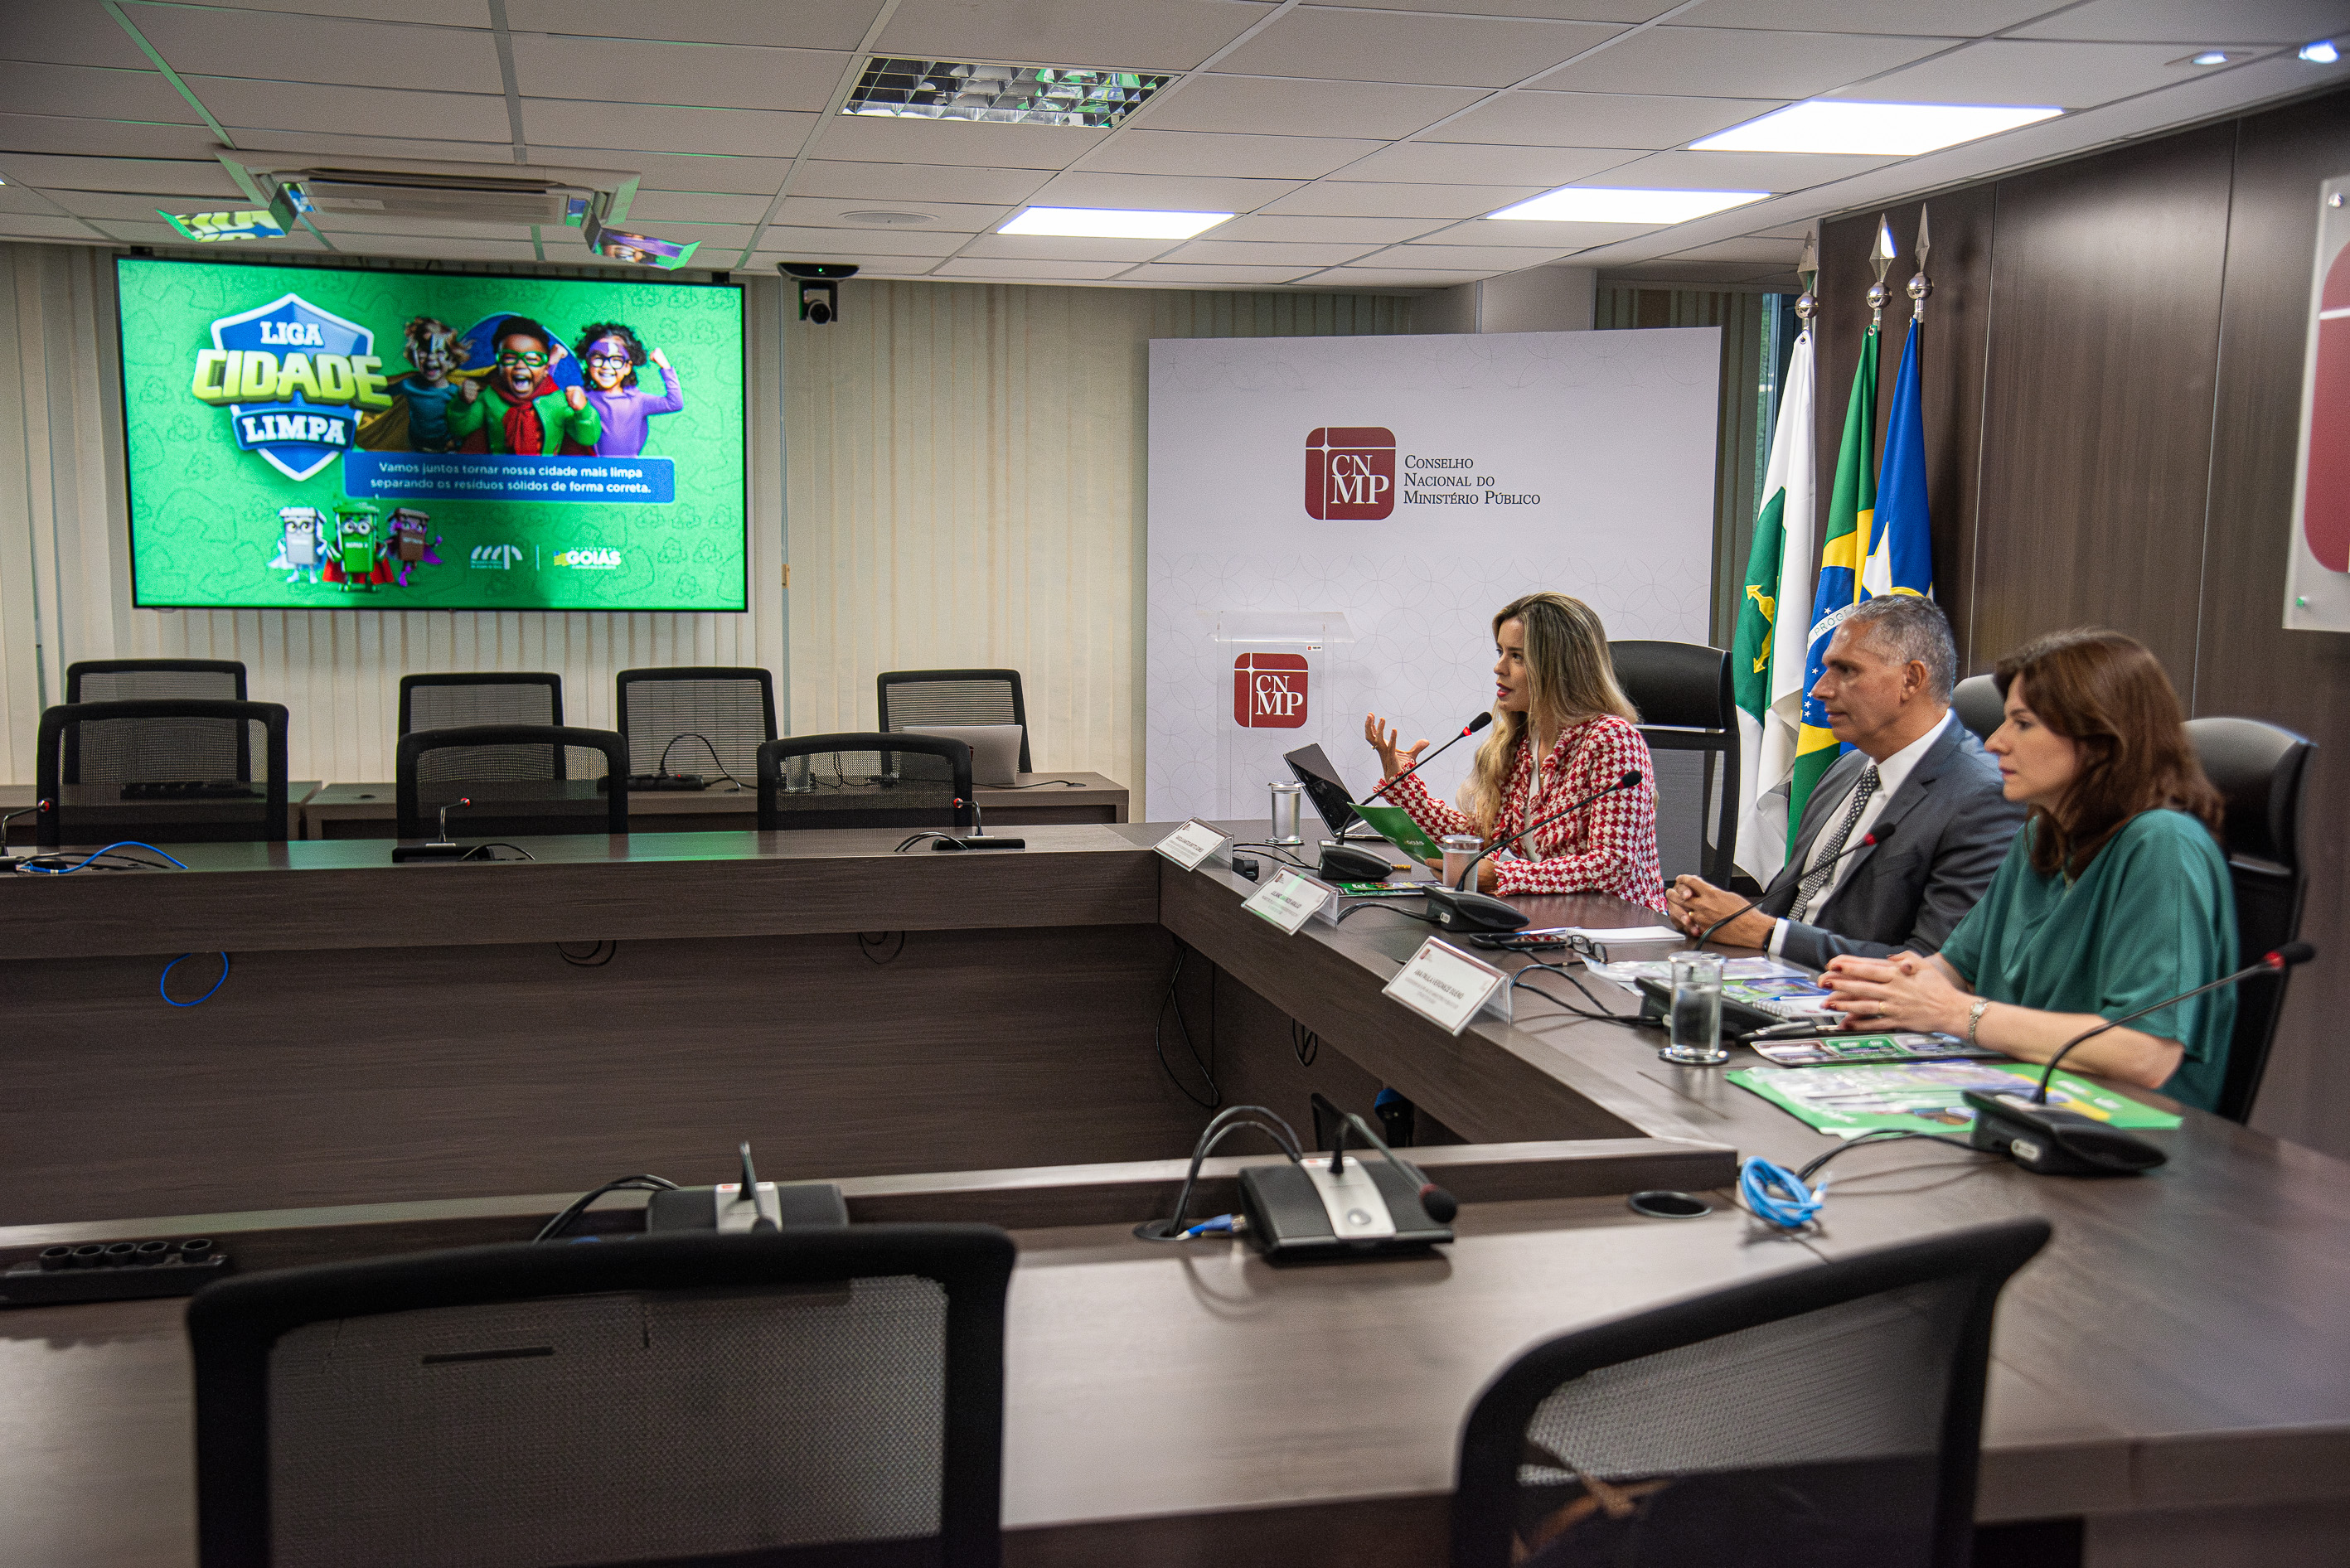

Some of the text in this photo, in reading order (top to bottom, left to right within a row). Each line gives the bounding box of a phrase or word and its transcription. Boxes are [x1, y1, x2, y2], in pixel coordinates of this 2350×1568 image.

[259, 321, 324, 346] LIGA
[191, 348, 394, 410] CIDADE
[241, 414, 346, 445] LIMPA
[378, 461, 643, 480] Vamos juntos tornar nossa cidade mais limpa
[1331, 454, 1374, 478] CN
[370, 477, 652, 495] separando os resíduos sólidos de forma correta.
[1330, 474, 1390, 505] MP
[565, 547, 622, 566] GOIÁS
[1255, 675, 1290, 694] CN
[1255, 691, 1304, 716] MP
